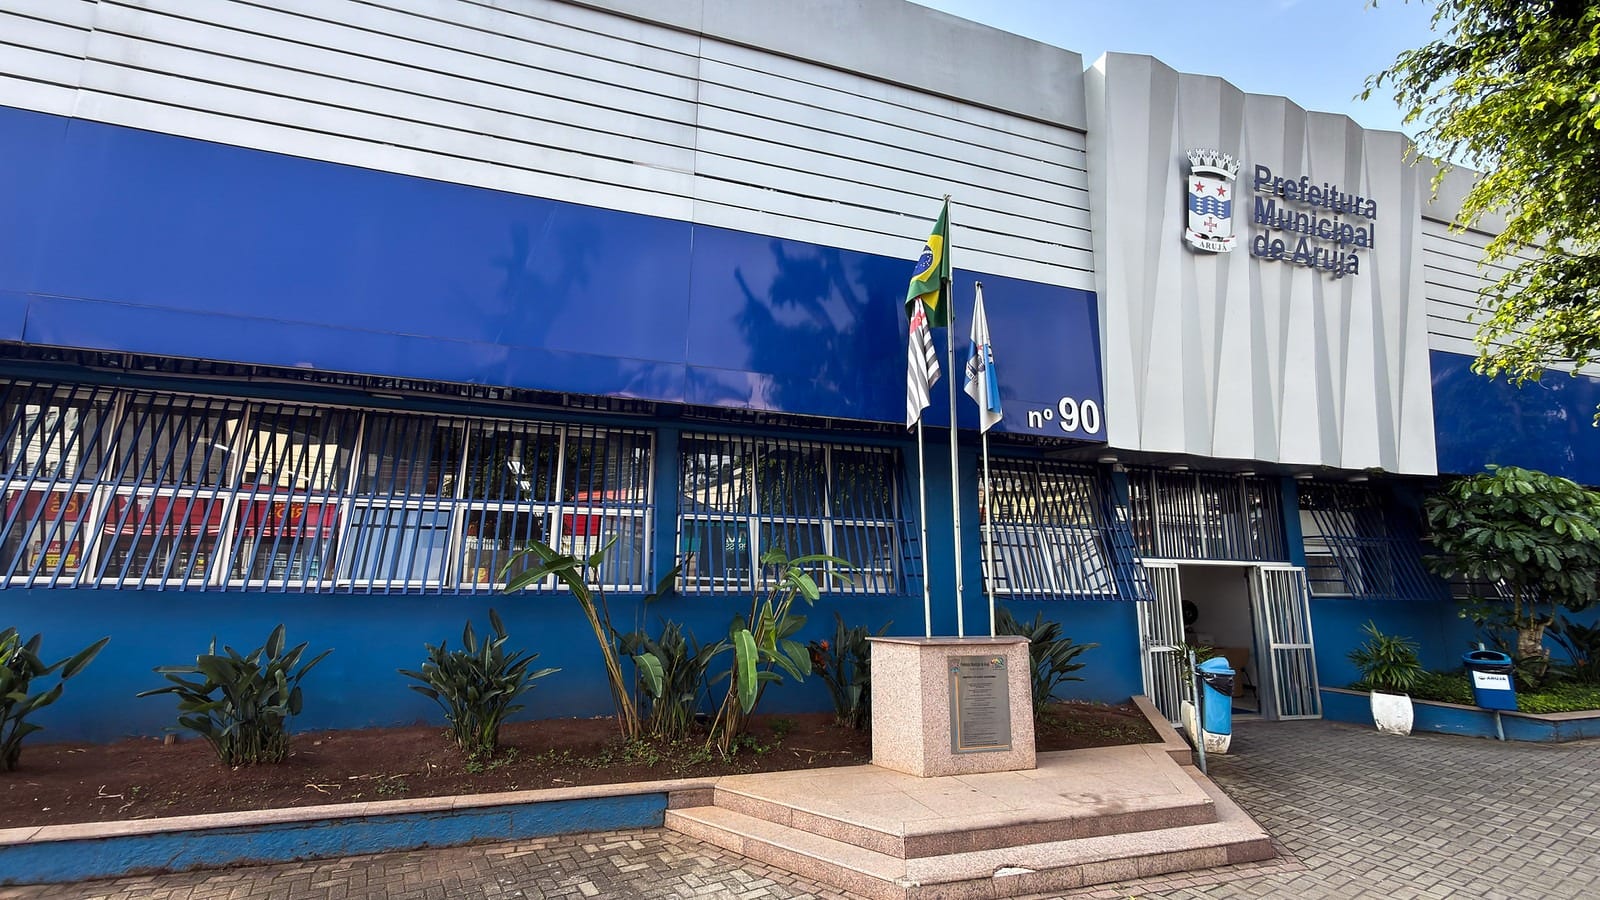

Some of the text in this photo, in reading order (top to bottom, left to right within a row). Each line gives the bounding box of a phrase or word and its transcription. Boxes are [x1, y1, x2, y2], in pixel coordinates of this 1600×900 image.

[1254, 164, 1377, 220] Prefeitura
[1254, 196, 1374, 249] Municipal
[1254, 230, 1359, 279] de Arujá
[1058, 397, 1100, 434] 90
